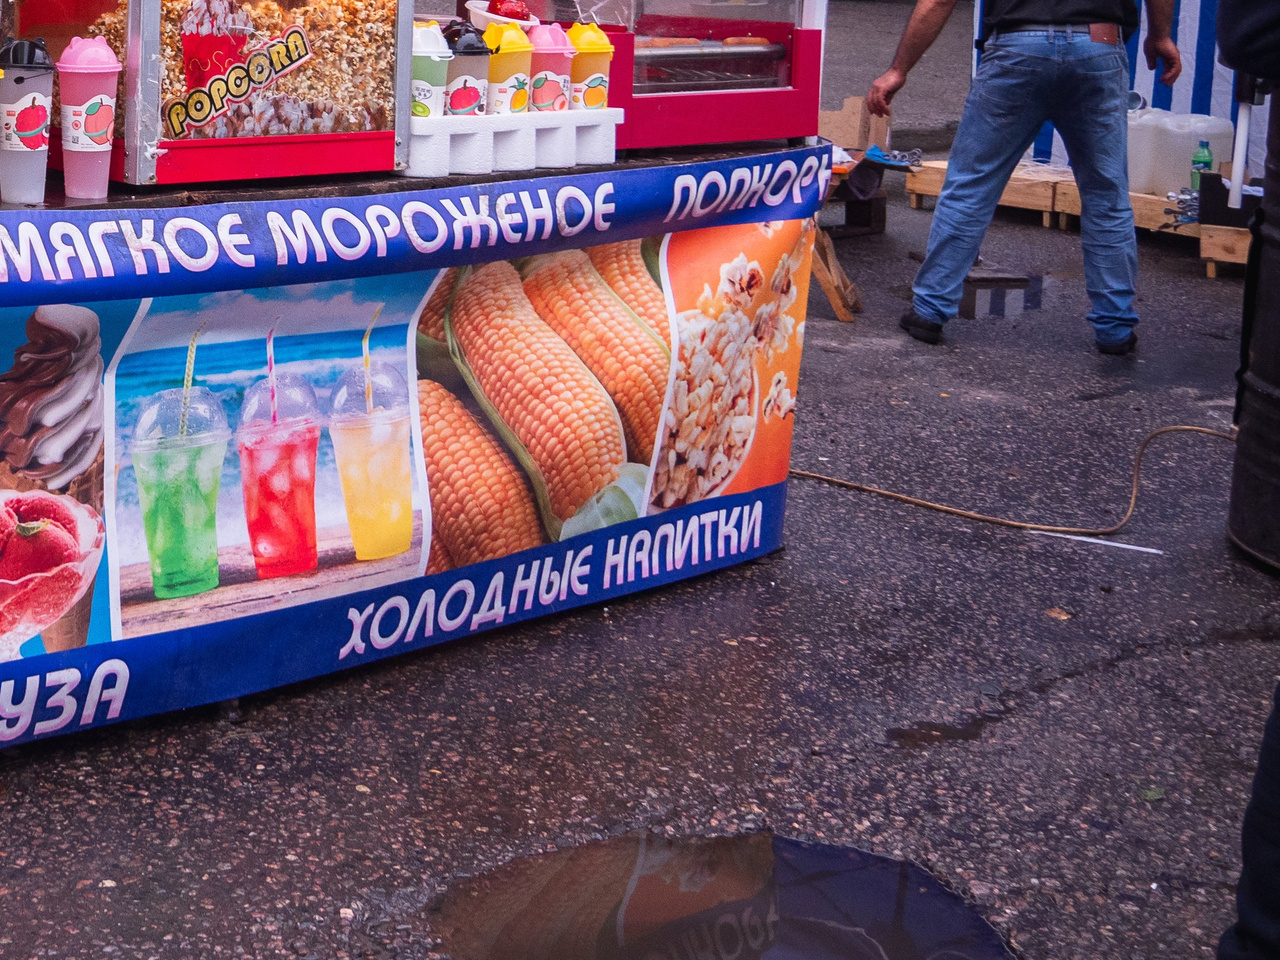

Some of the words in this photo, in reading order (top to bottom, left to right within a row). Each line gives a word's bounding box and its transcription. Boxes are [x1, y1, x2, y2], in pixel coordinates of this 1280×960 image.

[266, 182, 616, 265] МОРОЖЕНОЕ
[338, 544, 593, 661] ХОЛОДНЫЕ
[603, 500, 764, 589] НАПИТКИ
